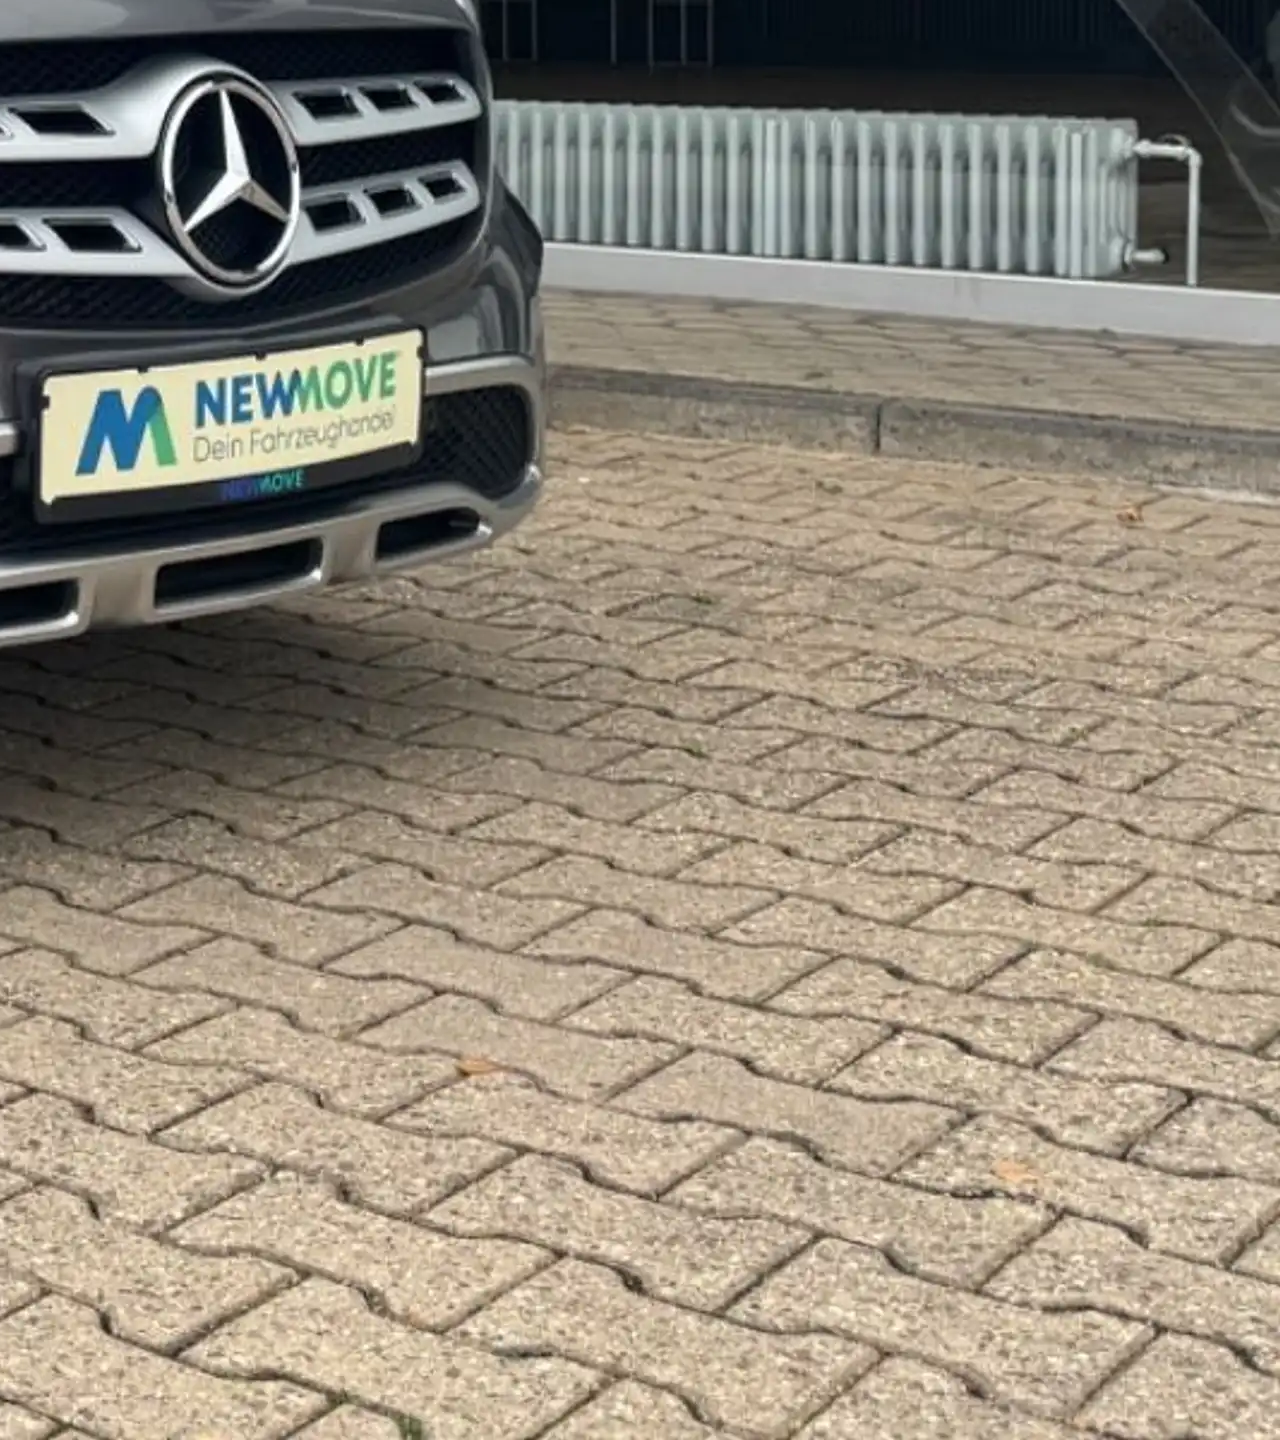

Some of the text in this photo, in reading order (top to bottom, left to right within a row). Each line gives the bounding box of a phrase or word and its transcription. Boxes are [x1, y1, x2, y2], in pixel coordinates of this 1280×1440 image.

[195, 350, 399, 428] NEWMOVE
[193, 404, 396, 462] Dein Fahrzeughandel
